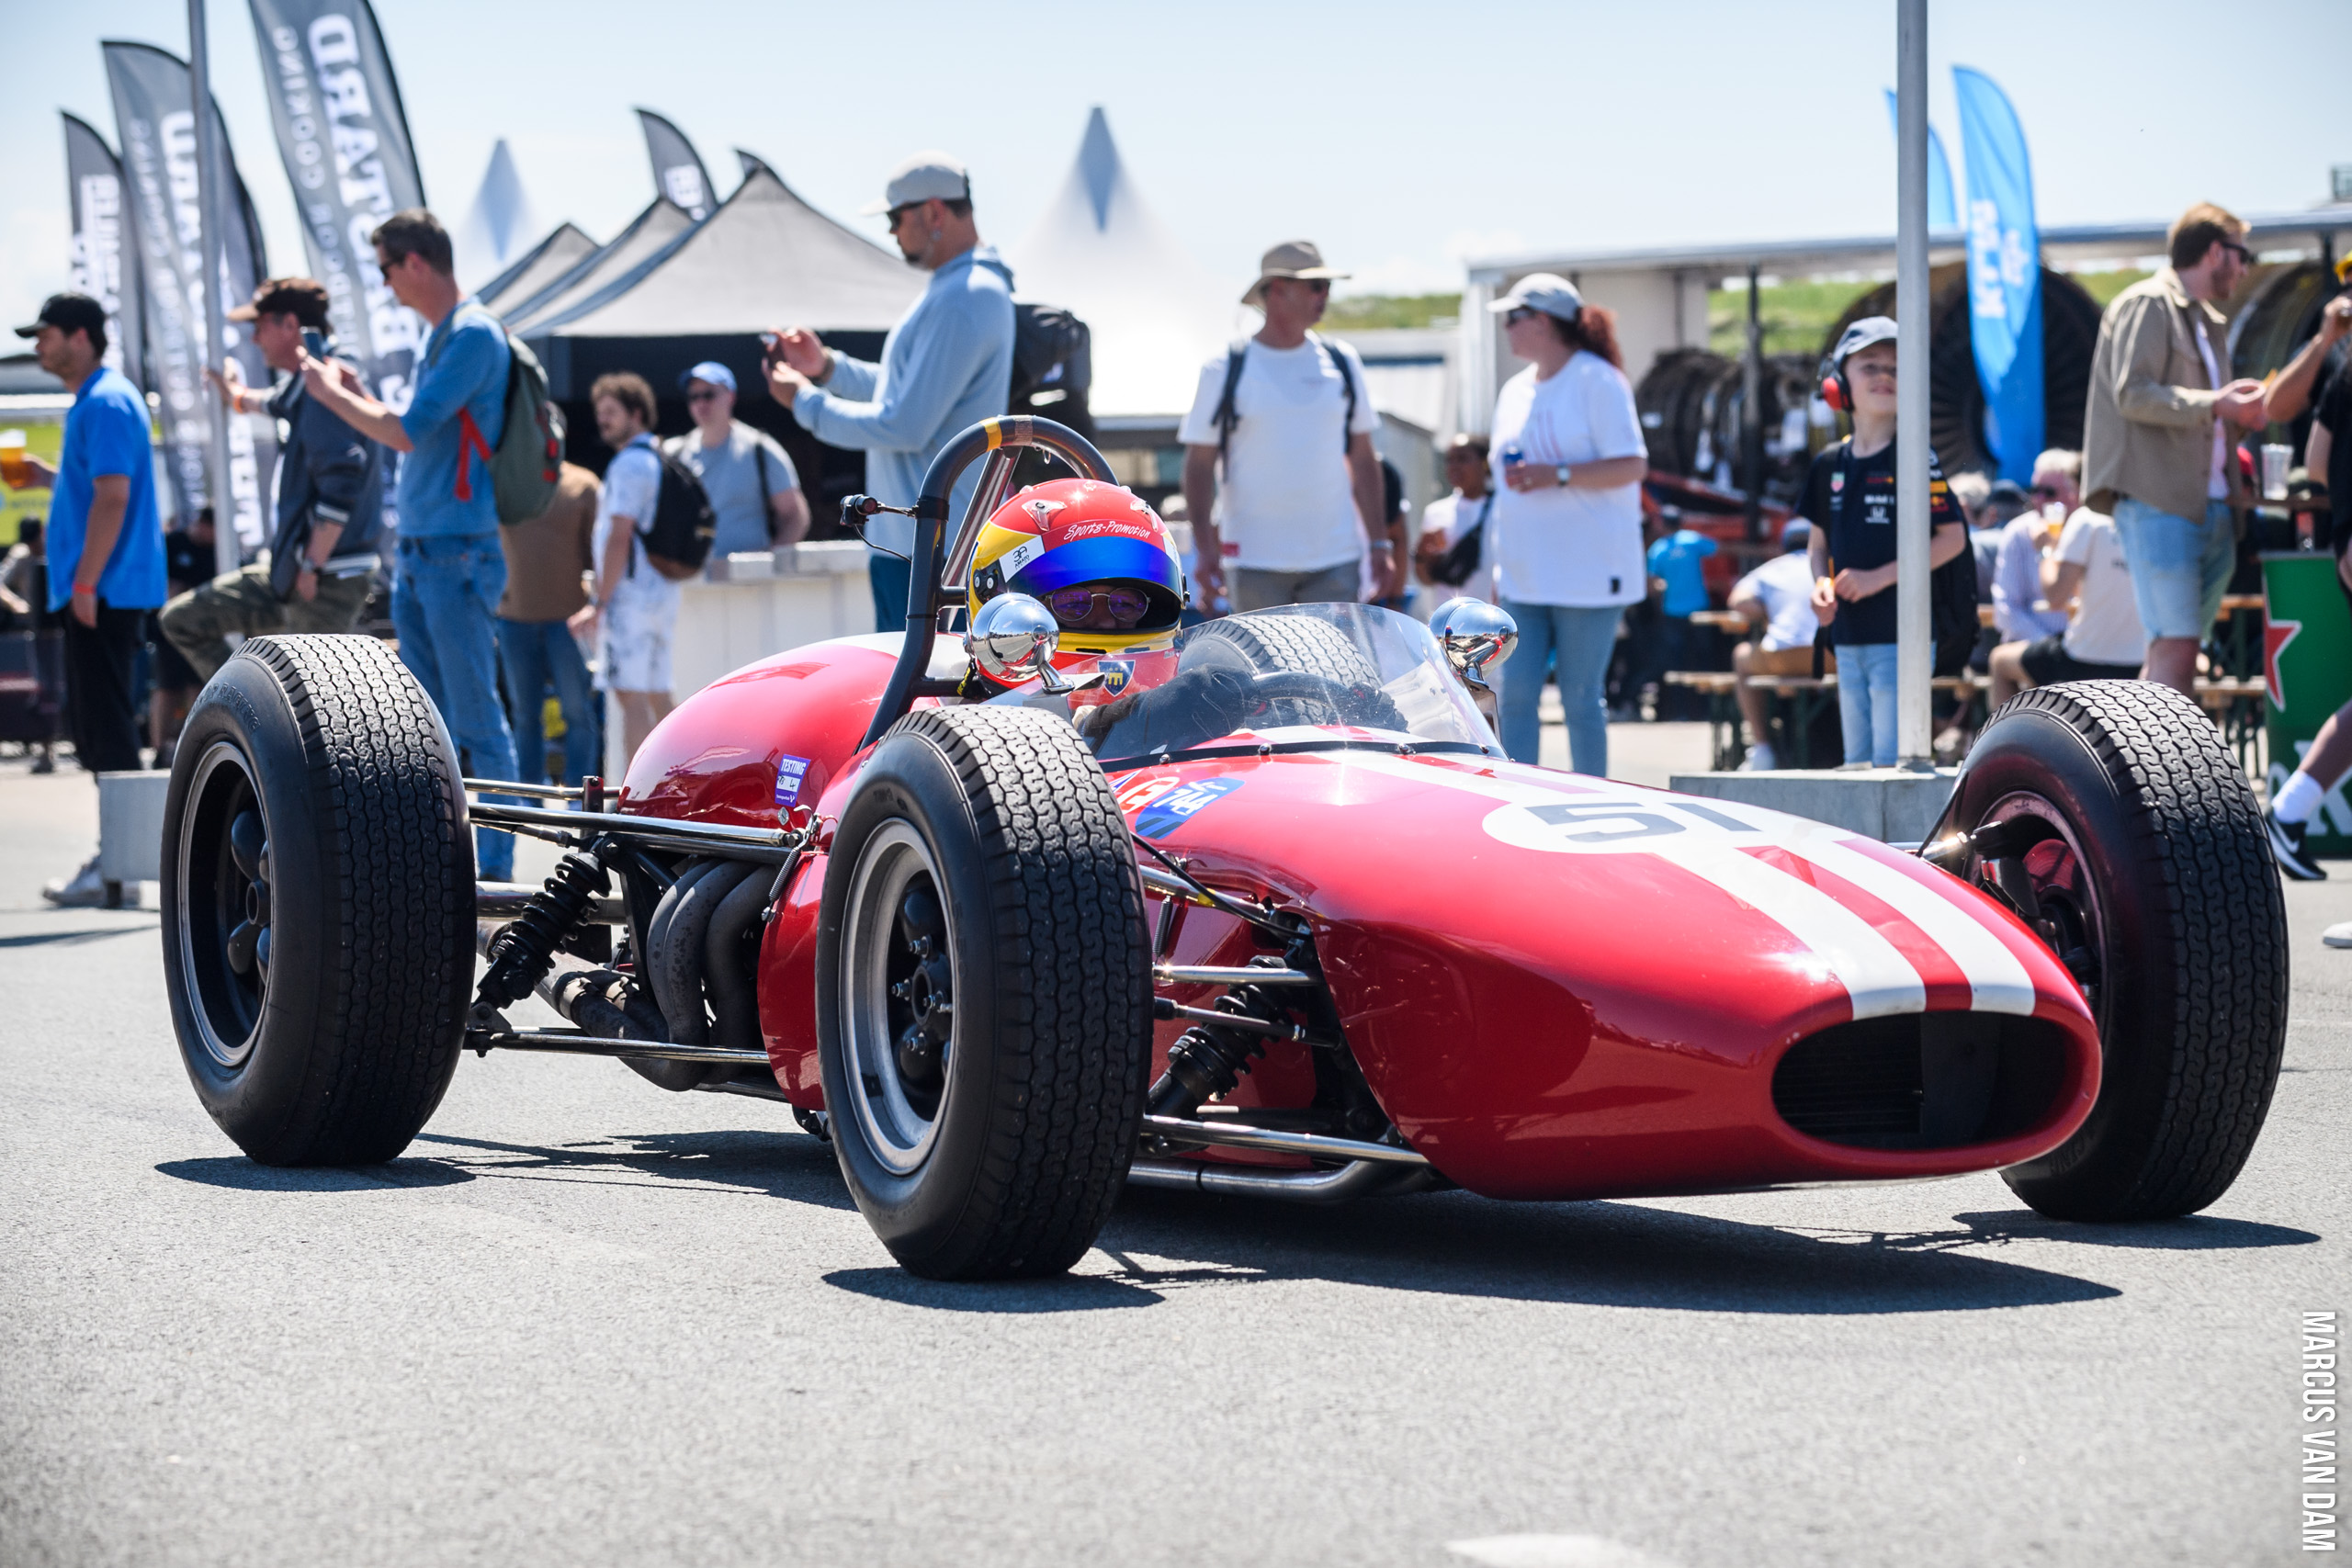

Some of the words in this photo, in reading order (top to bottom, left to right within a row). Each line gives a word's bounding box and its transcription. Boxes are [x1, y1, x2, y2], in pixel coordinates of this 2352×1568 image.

[1063, 520, 1151, 542] Sports-Promotion
[1014, 554, 1030, 568] AMATO
[781, 758, 807, 776] TESTING
[1523, 802, 1764, 843] 51
